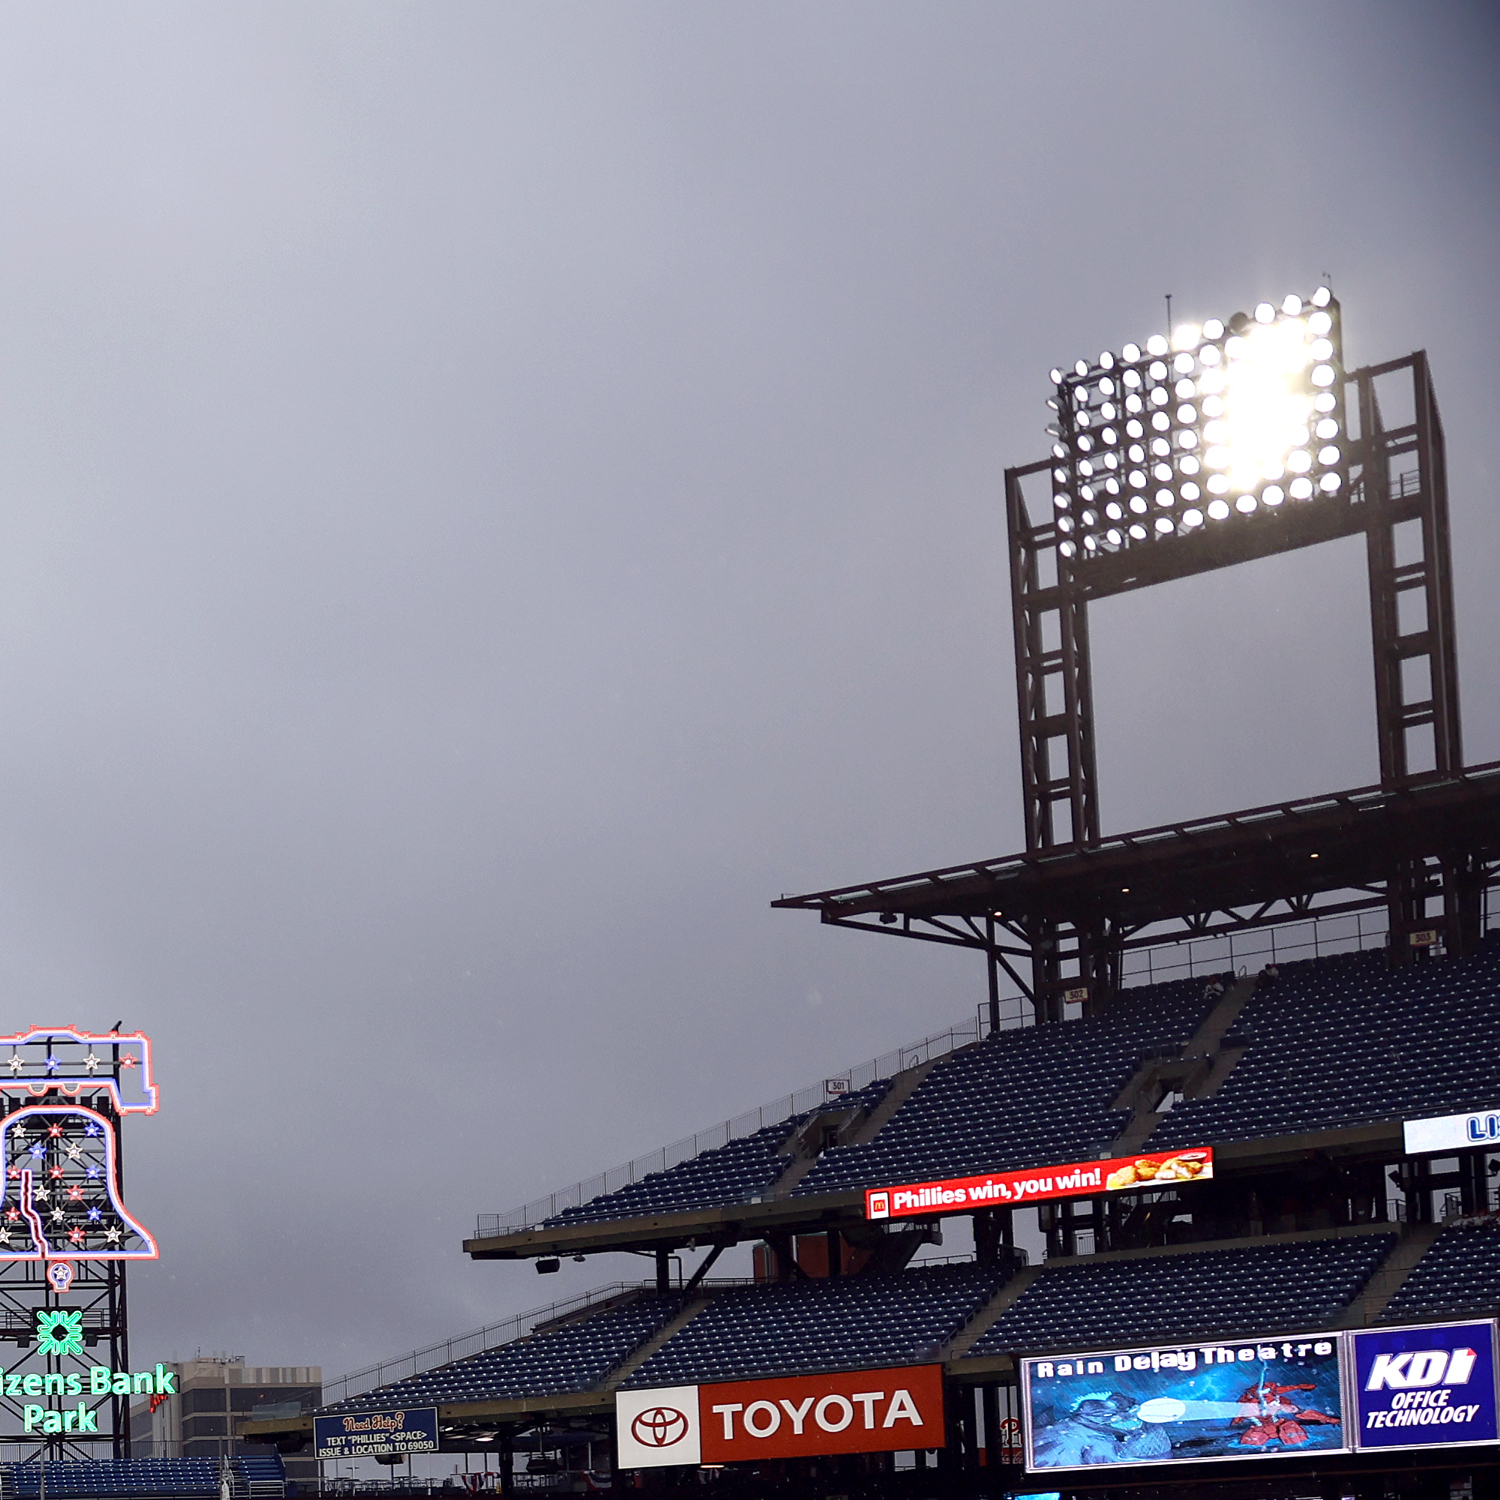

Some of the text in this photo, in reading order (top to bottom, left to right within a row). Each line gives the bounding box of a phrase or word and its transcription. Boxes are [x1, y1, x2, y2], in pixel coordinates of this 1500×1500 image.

[893, 1168, 1101, 1212] Phillies win, you win!
[1037, 1338, 1333, 1379] Rain Delay Theatre
[1364, 1346, 1477, 1392] KDI
[90, 1363, 175, 1395] Bank
[711, 1389, 924, 1441] TOYOTA
[1391, 1389, 1452, 1410] OFFICE
[23, 1401, 98, 1433] Park
[343, 1411, 405, 1432] Need Help?
[1366, 1404, 1480, 1429] TECHNOLOGY
[319, 1440, 434, 1457] ISSUE LOCATION TO 69050
[326, 1436, 347, 1447] TEXT
